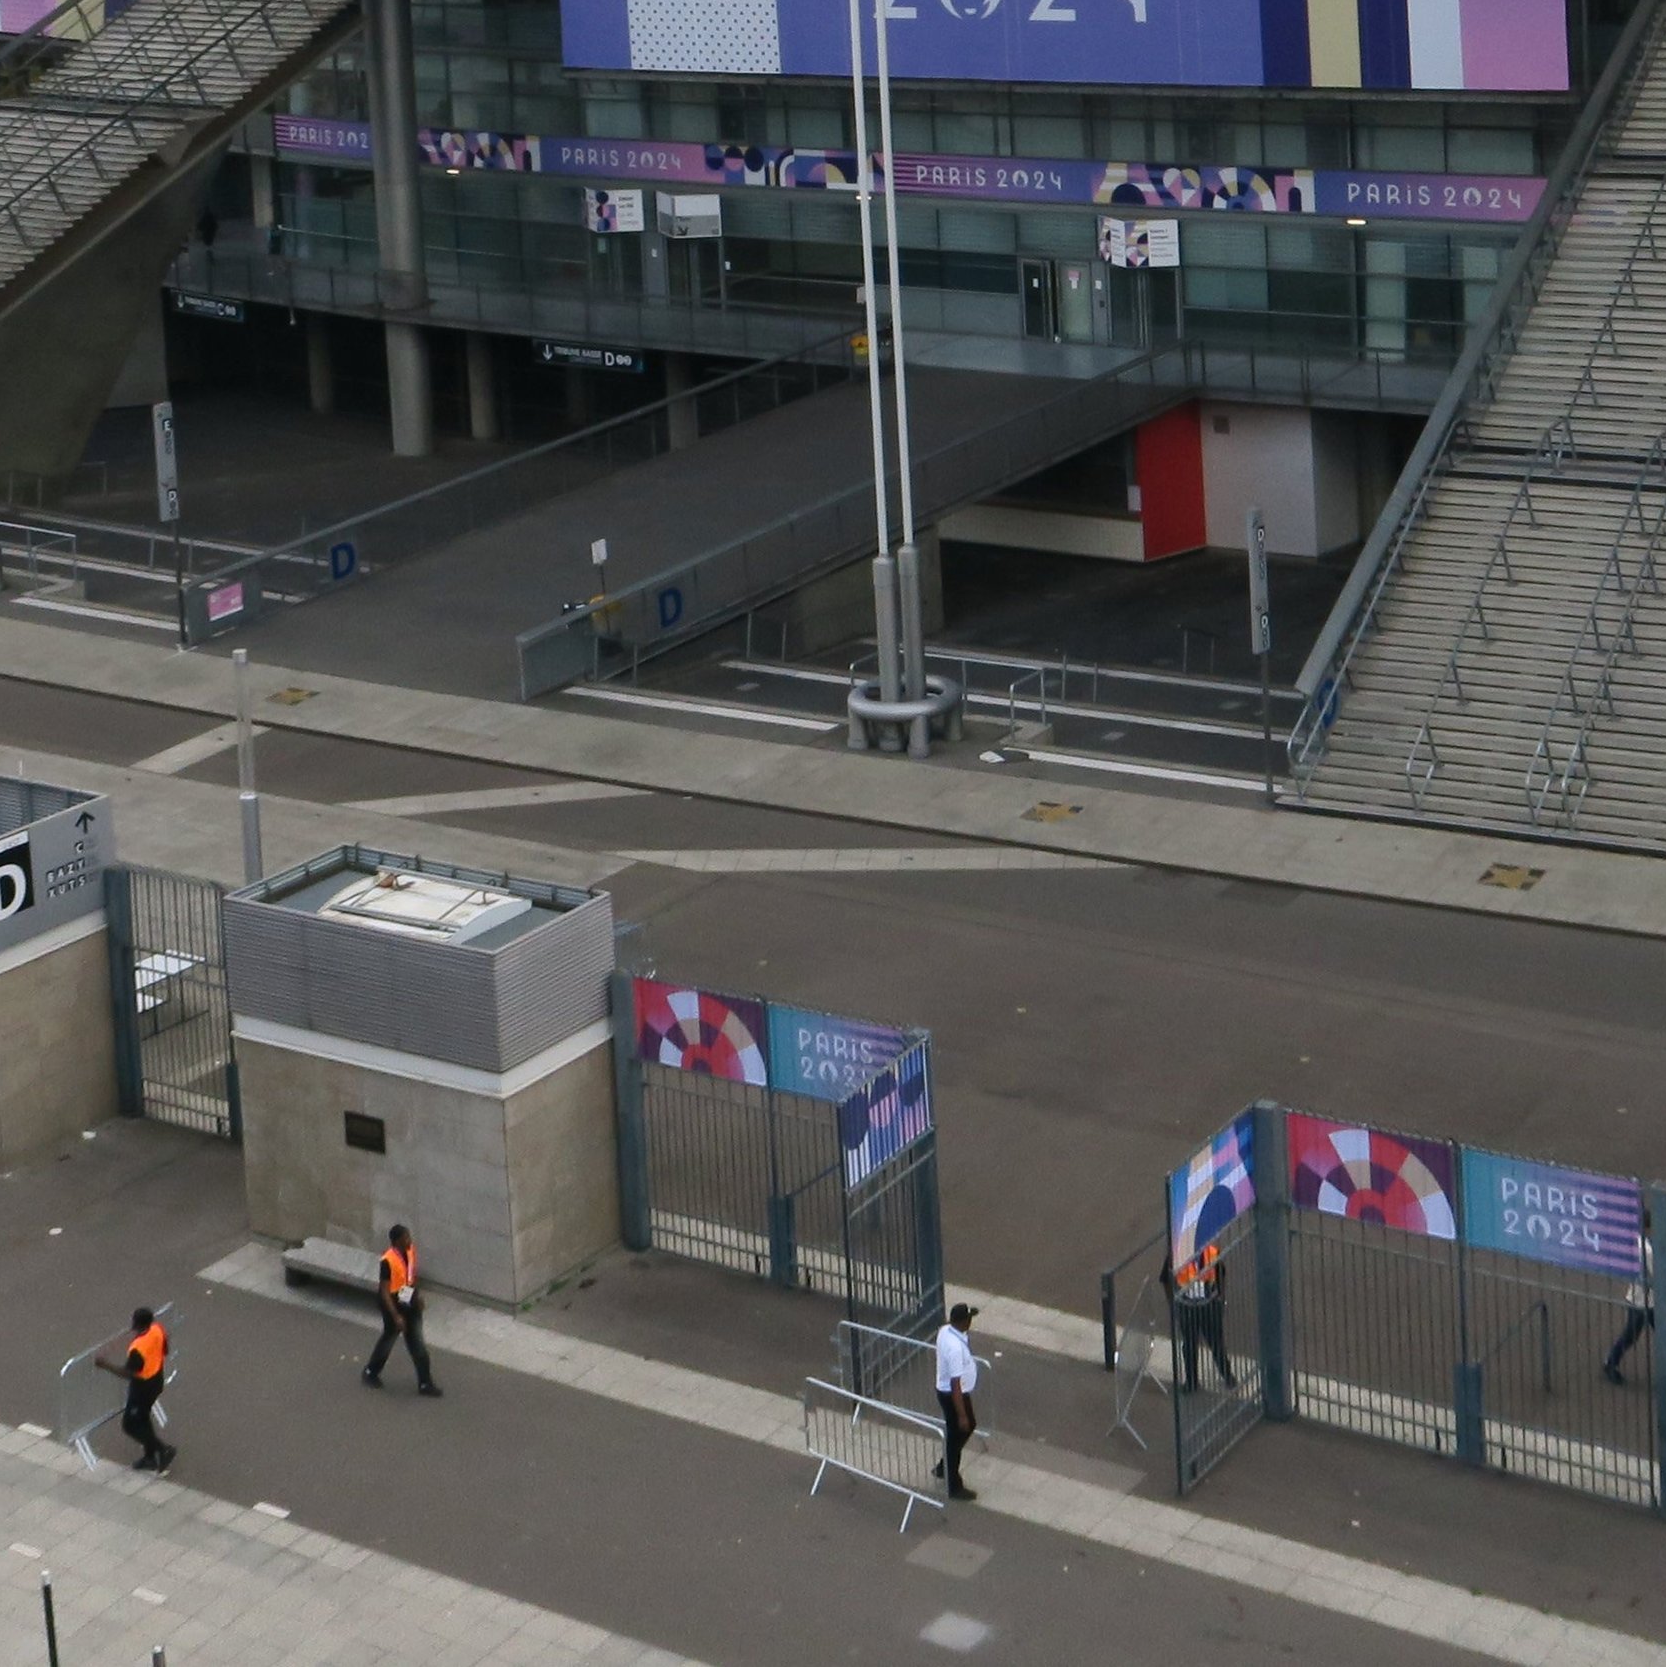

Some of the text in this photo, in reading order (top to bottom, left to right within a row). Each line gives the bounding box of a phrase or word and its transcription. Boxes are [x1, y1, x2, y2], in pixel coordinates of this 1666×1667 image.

[626, 150, 682, 170] 2024
[997, 168, 1062, 191] 2024
[1443, 186, 1521, 210] 2024
[604, 352, 615, 367] D
[331, 541, 355, 580] D
[658, 587, 682, 629] D
[1502, 1208, 1601, 1253] 2024
